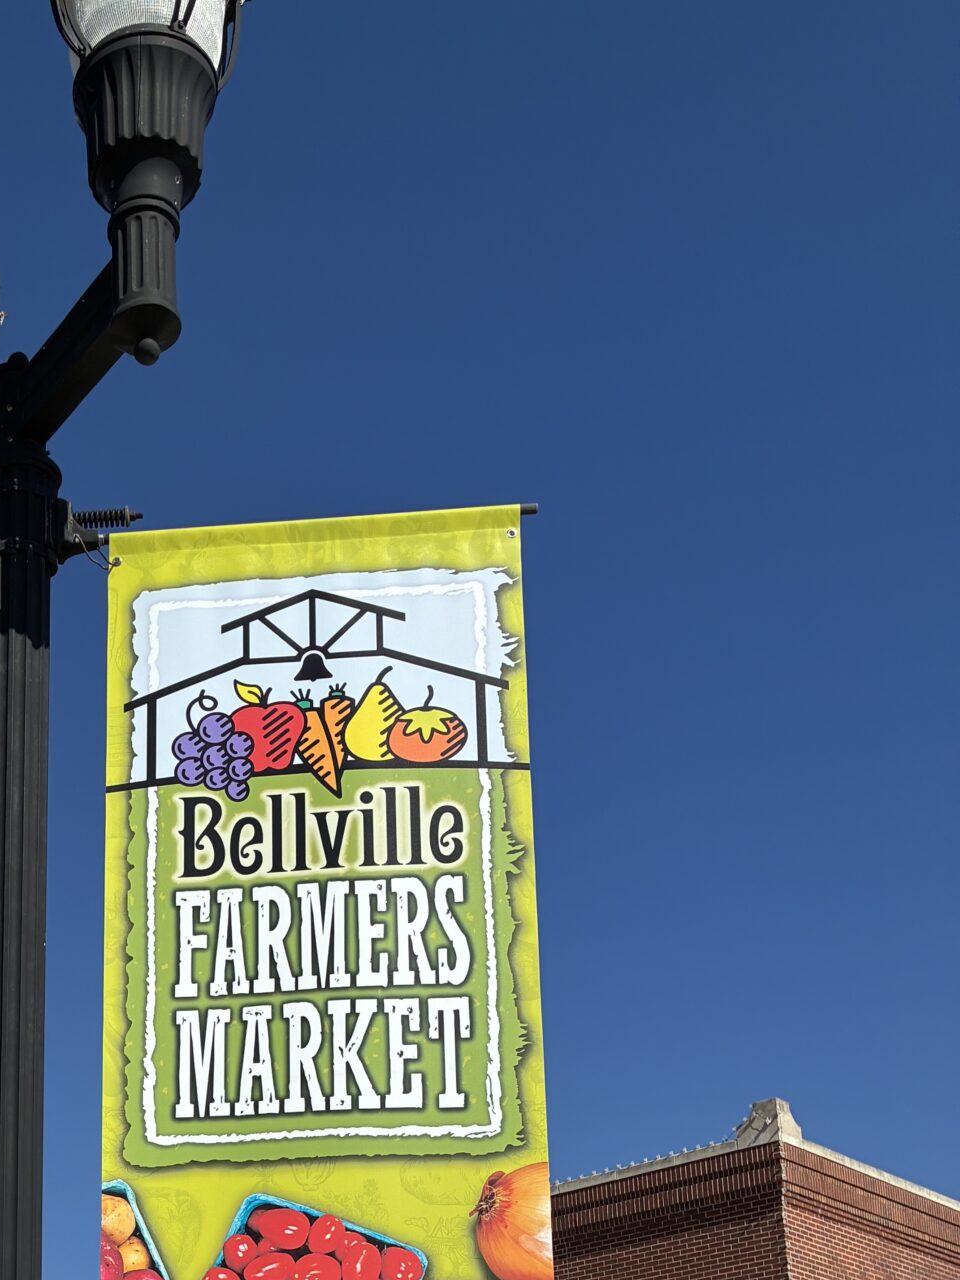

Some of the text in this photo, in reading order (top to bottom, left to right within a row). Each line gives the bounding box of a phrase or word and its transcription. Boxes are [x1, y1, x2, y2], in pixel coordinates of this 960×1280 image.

[176, 786, 465, 878] Bellville
[172, 874, 472, 998] FARMERS
[173, 996, 472, 1119] MARKET
